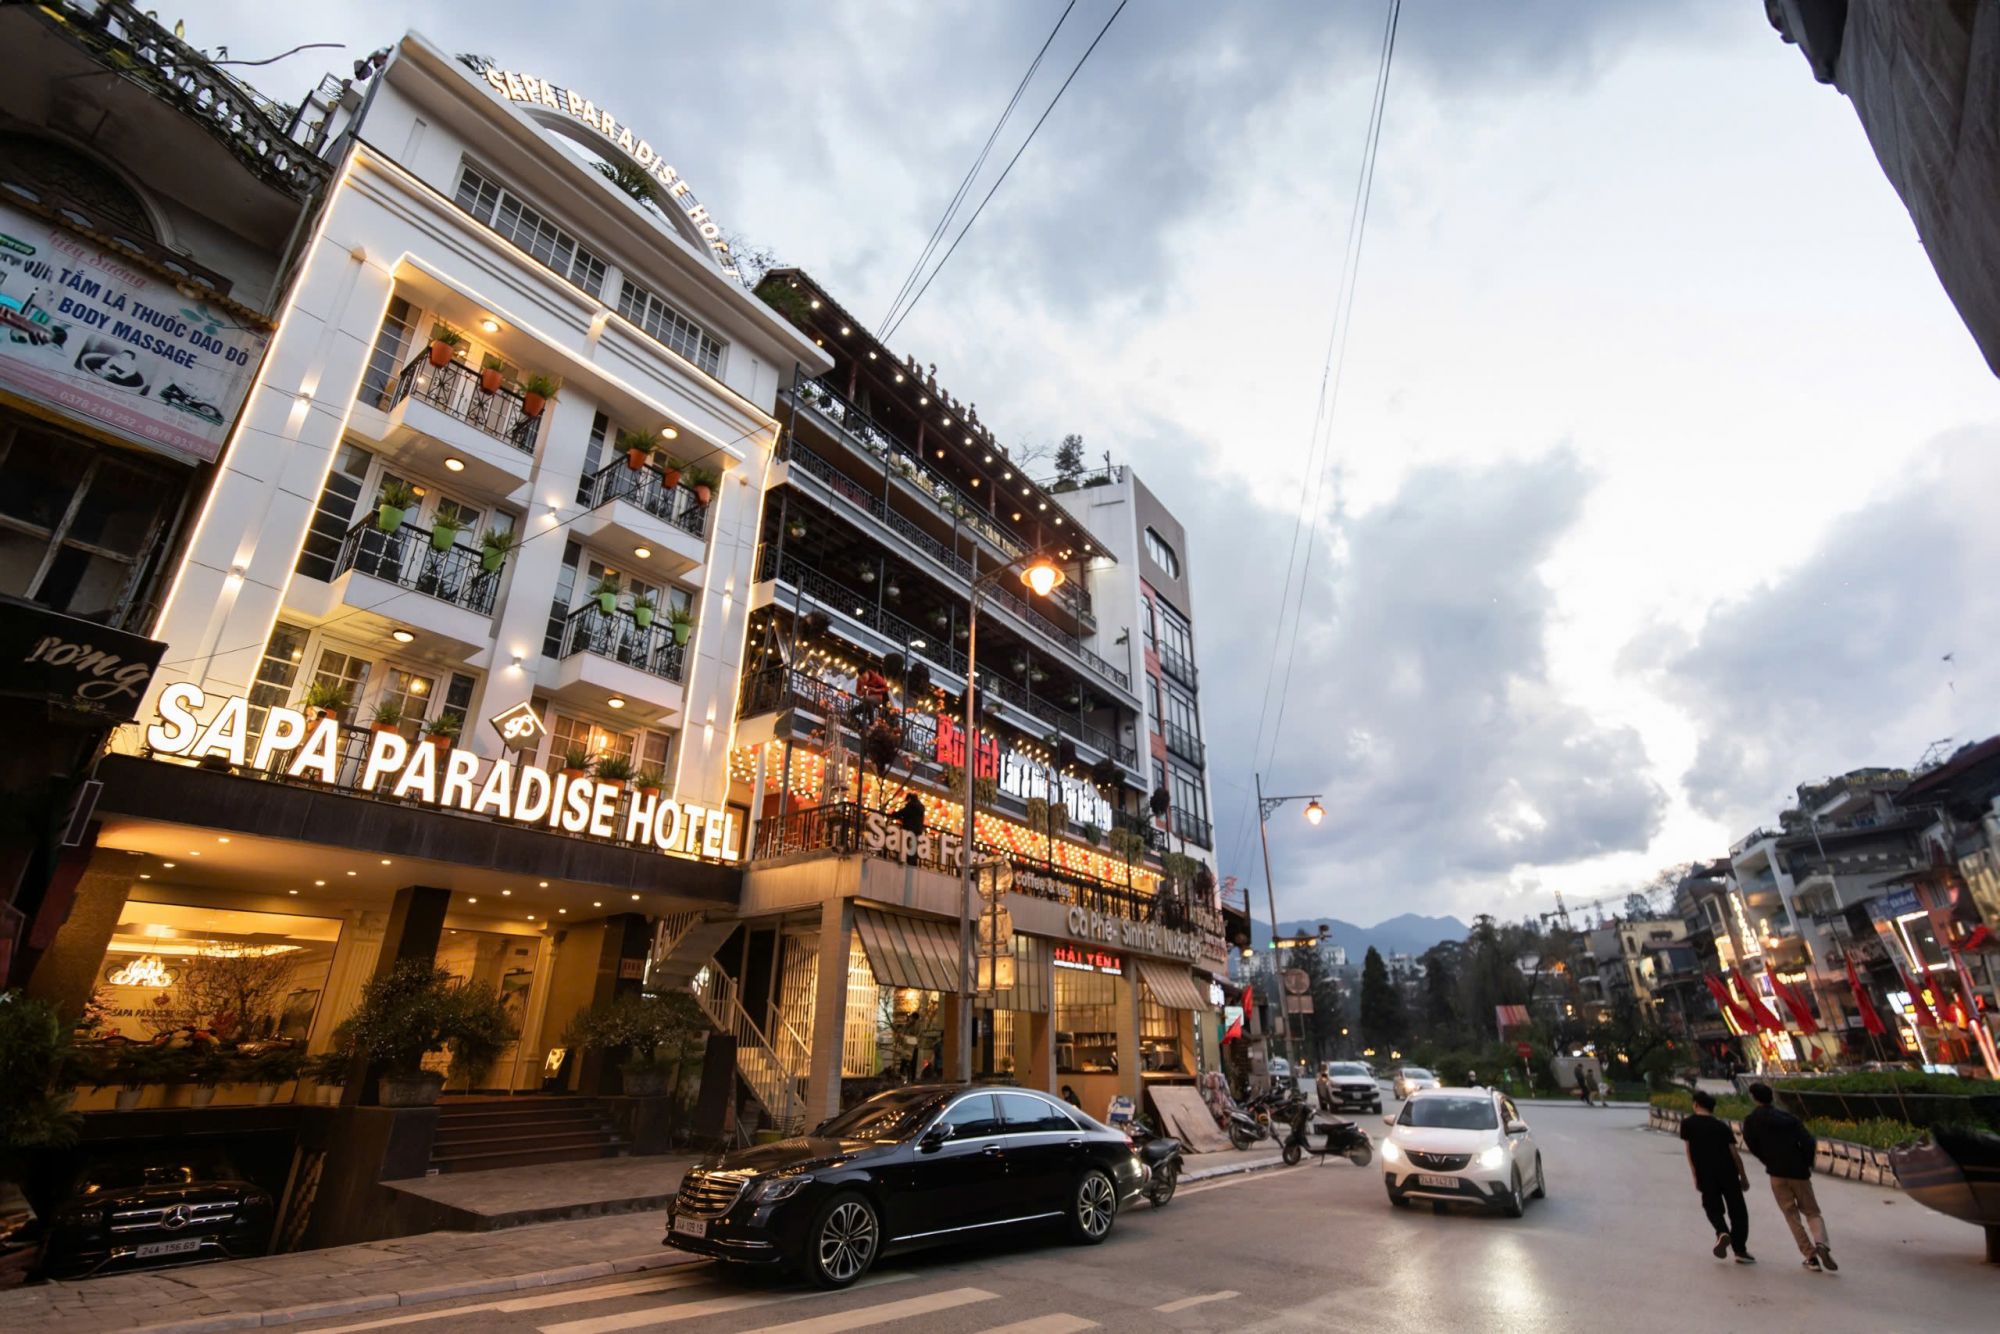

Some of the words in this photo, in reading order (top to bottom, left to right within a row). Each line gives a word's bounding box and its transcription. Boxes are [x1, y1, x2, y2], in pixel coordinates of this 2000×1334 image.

[485, 68, 559, 110] SAPA
[565, 88, 691, 199] PARADISE
[57, 296, 110, 330] BODY
[111, 321, 198, 370] MASSAGE
[58, 268, 100, 299] TẮM
[104, 288, 125, 312] LÁ
[128, 302, 187, 338] THUỐC
[188, 329, 224, 356] DAO
[225, 347, 249, 368] ĐỎ
[147, 681, 340, 784] SAPA
[361, 729, 620, 838] PARADISE
[624, 790, 739, 862] HOTEL
[866, 813, 932, 863] Sapa
[1015, 870, 1046, 892] coffee
[1056, 880, 1071, 897] tea
[1055, 945, 1082, 963] HẢI
[1086, 948, 1112, 967] YẾN
[1068, 905, 1088, 937] Cà
[1122, 919, 1144, 947] Sinh
[1163, 925, 1188, 956] Nước
